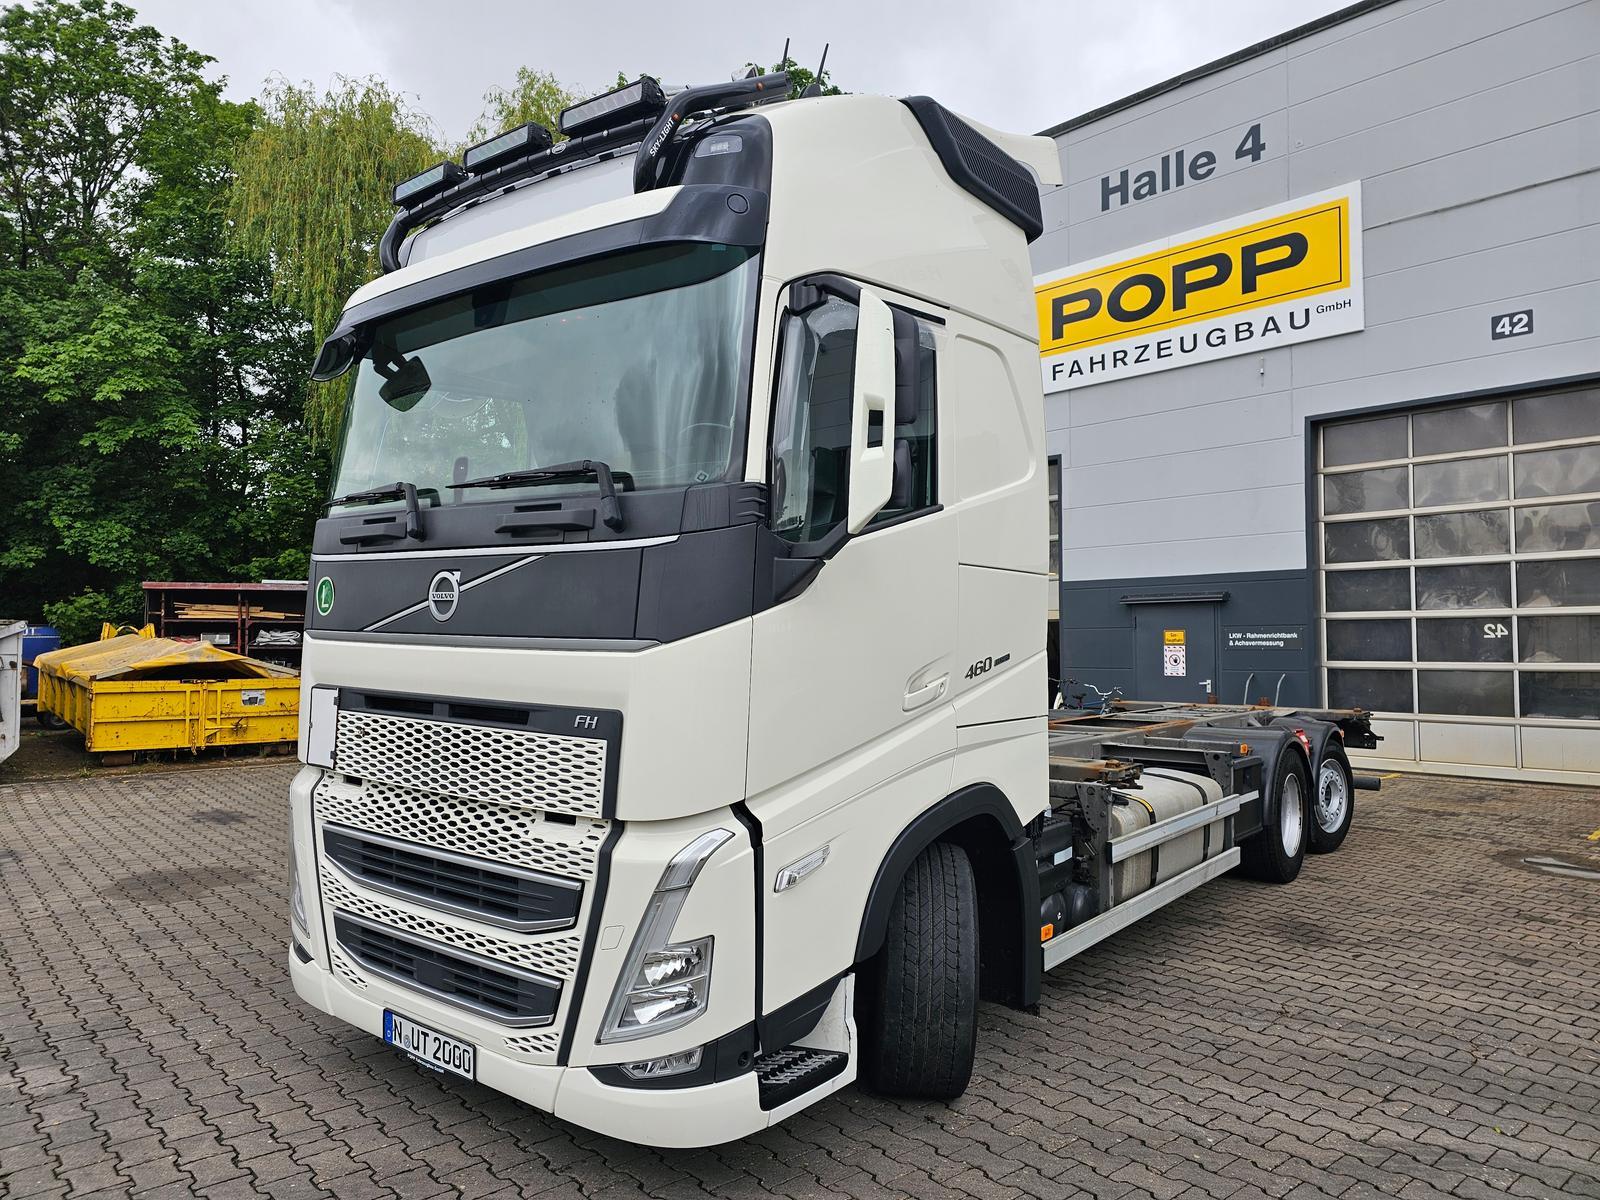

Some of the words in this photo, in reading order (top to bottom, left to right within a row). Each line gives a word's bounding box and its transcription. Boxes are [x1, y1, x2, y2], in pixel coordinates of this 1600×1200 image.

[649, 117, 674, 157] SKY-LIGHT
[1100, 148, 1217, 211] Halle
[1235, 123, 1266, 163] 4
[1051, 231, 1309, 341] POPP
[1051, 307, 1311, 382] FAHRZEUGBAU
[1316, 298, 1352, 315] GmbH
[1495, 313, 1529, 335] 42
[1234, 640, 1284, 648] Achsvermessung
[965, 656, 992, 679] 460
[574, 715, 598, 728] FH
[393, 1018, 402, 1044] N
[411, 1026, 429, 1055] UT
[433, 1036, 471, 1074] 2000
